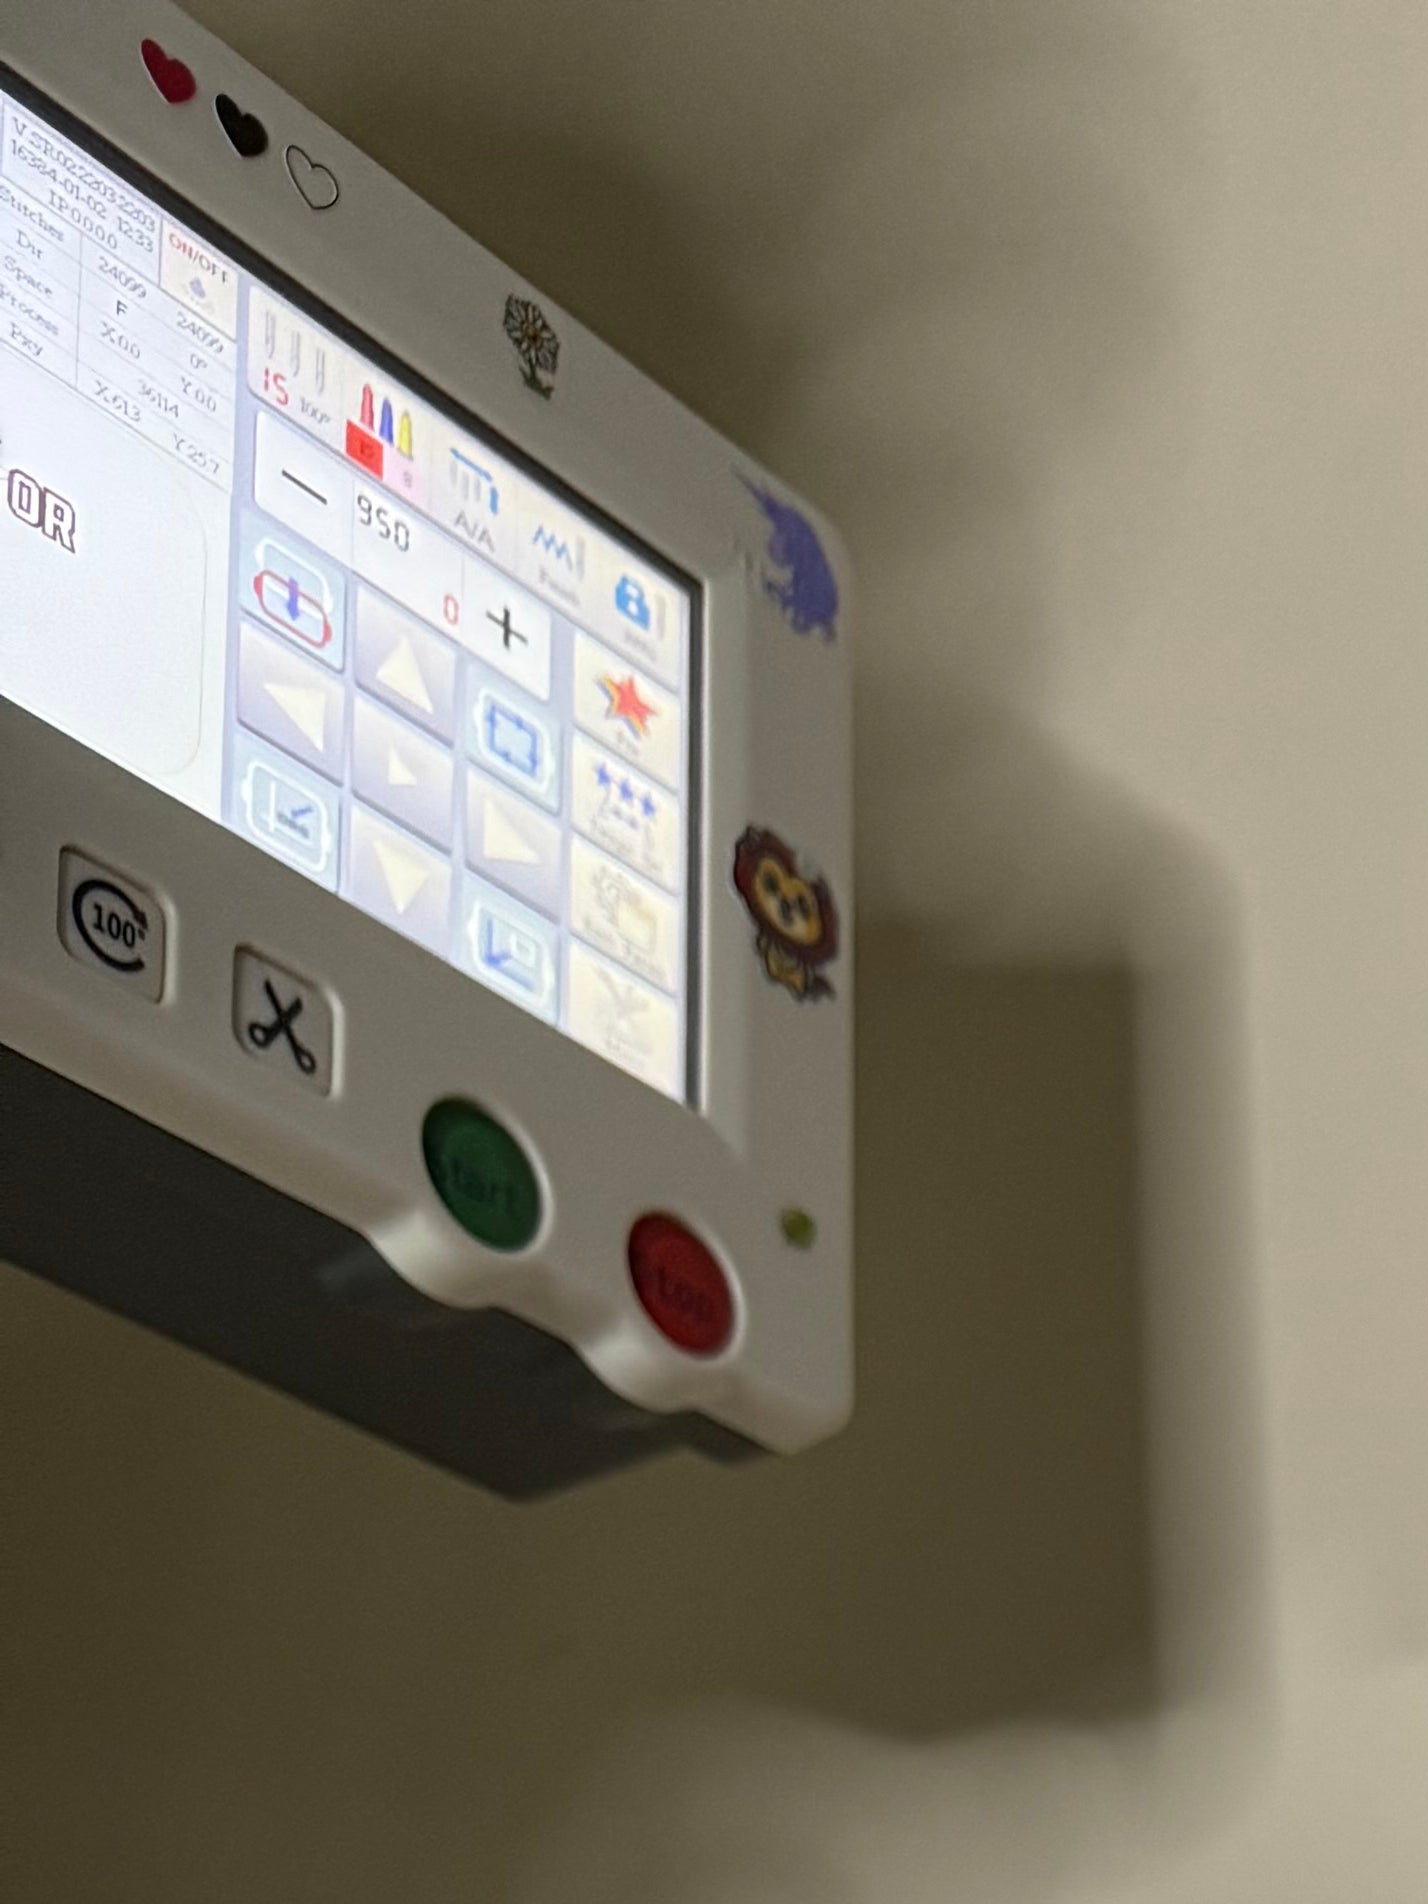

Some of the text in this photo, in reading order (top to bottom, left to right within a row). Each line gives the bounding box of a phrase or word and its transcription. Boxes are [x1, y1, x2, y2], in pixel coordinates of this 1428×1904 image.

[116, 300, 128, 316] F
[263, 367, 288, 406] 15
[7, 468, 76, 554] OR
[356, 493, 410, 553] 950
[444, 593, 460, 626] 0
